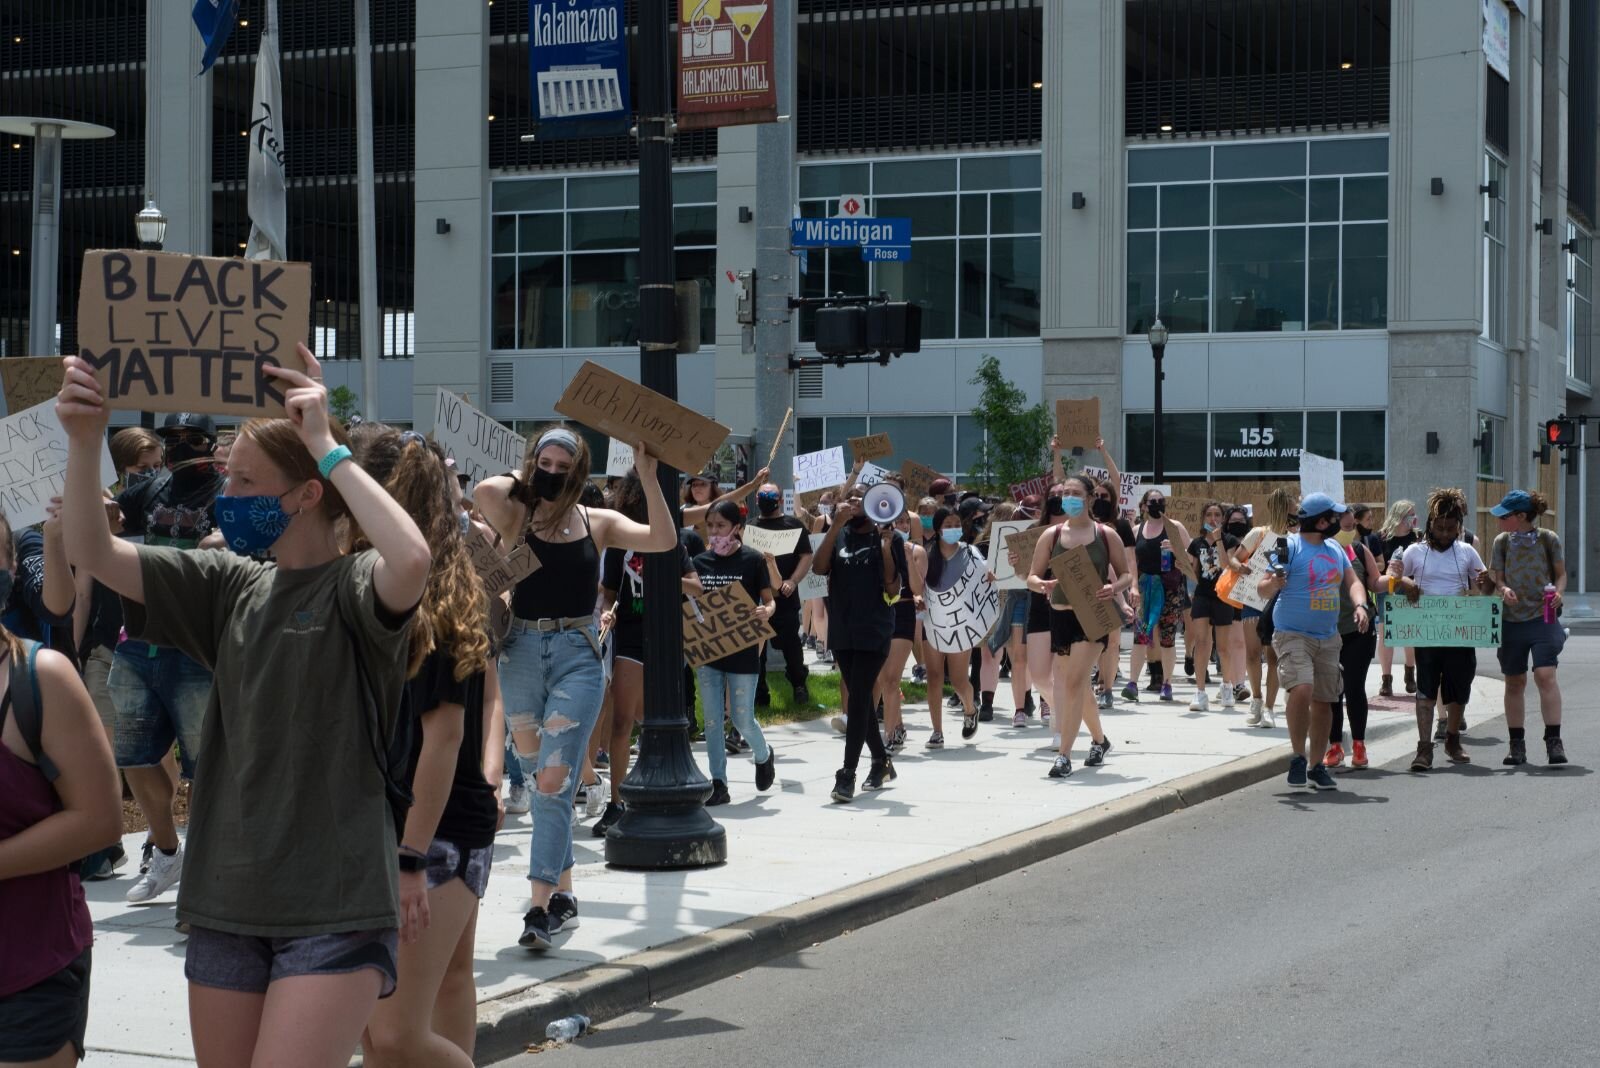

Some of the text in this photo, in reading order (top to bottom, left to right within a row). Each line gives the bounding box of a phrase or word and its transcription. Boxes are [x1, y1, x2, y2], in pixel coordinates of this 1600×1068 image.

[534, 4, 618, 47] Kalamazoo
[682, 63, 769, 95] KALAMAZOO MALL
[705, 96, 743, 104] DISTRICT
[795, 220, 893, 245] W Michigan
[874, 248, 898, 259] Rose
[102, 252, 288, 311] BLACK
[108, 305, 283, 354] LIVES
[81, 347, 287, 408] MATTER
[571, 371, 620, 416] Fuck
[438, 391, 527, 471] NO JUSTICE
[1240, 427, 1274, 445] 155
[798, 447, 840, 472] BLACK
[1213, 448, 1227, 458] W.
[1230, 448, 1277, 458] MICHIGAN
[928, 573, 991, 629] LIVES
[682, 603, 752, 644] LIVES
[683, 617, 772, 665] MATTER
[1395, 623, 1488, 641] BLACK LIVES MATTER
